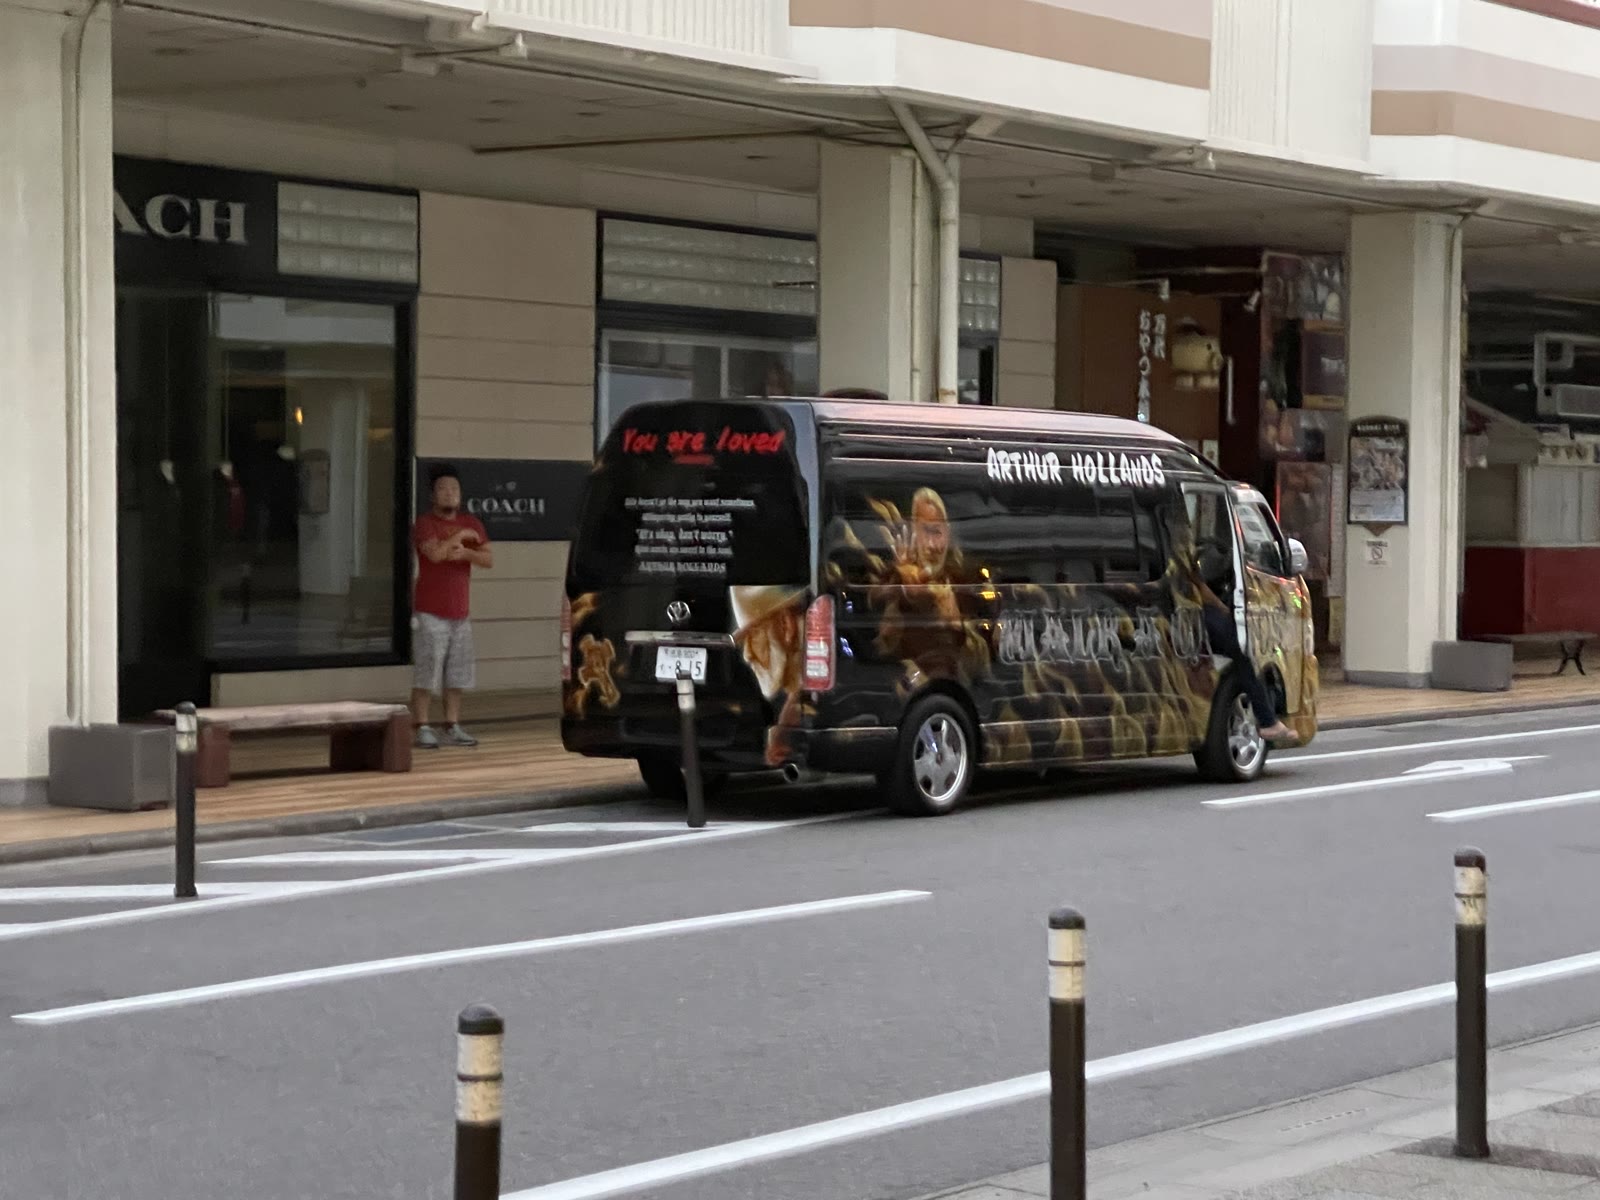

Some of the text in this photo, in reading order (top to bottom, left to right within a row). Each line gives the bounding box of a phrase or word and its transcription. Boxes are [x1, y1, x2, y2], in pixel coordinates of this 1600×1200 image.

[623, 425, 786, 453] You are loved
[987, 447, 1166, 487] ARTHUR HOLLANDS
[467, 498, 545, 515] COACH
